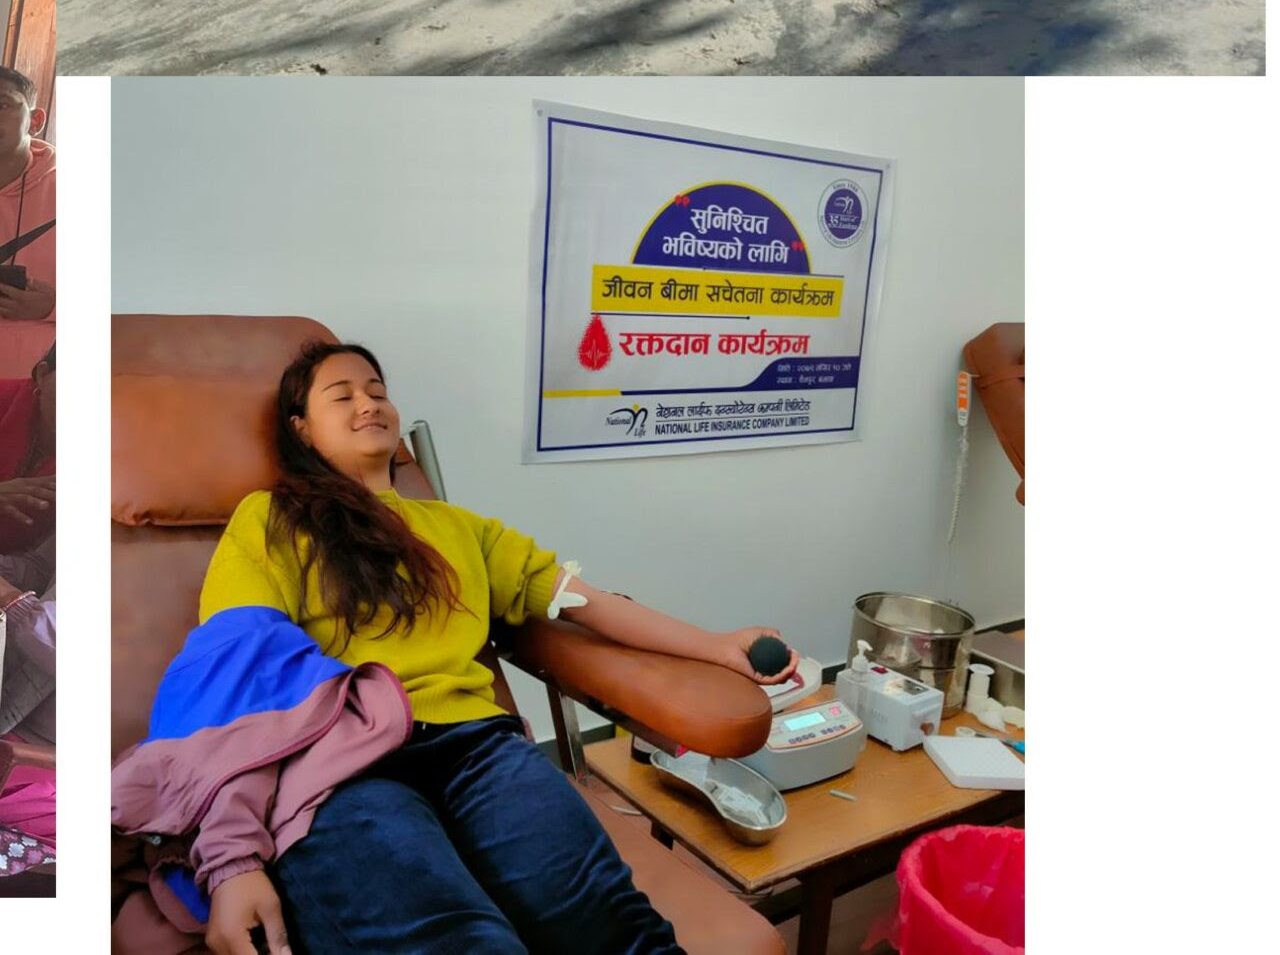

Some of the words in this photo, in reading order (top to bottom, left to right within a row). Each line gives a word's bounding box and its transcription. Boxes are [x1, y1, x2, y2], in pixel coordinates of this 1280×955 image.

[691, 204, 770, 235] सुनिश्चित
[662, 232, 744, 262] भविष्यको
[747, 240, 790, 264] लागि
[602, 275, 654, 301] जीवन
[660, 278, 700, 302] बीमा
[706, 280, 765, 305] सचेतना
[770, 282, 835, 307] कार्यक्रम
[618, 332, 712, 357] रक्तदान
[717, 329, 811, 357] कार्यक्रम
[606, 417, 632, 427] National
[634, 427, 647, 438] Life
[655, 421, 692, 436] NATIONAL
[693, 420, 710, 433] LIFE
[711, 418, 751, 432] INSURANCE
[752, 416, 784, 430] COMPANY
[785, 415, 810, 427] LIMITED
